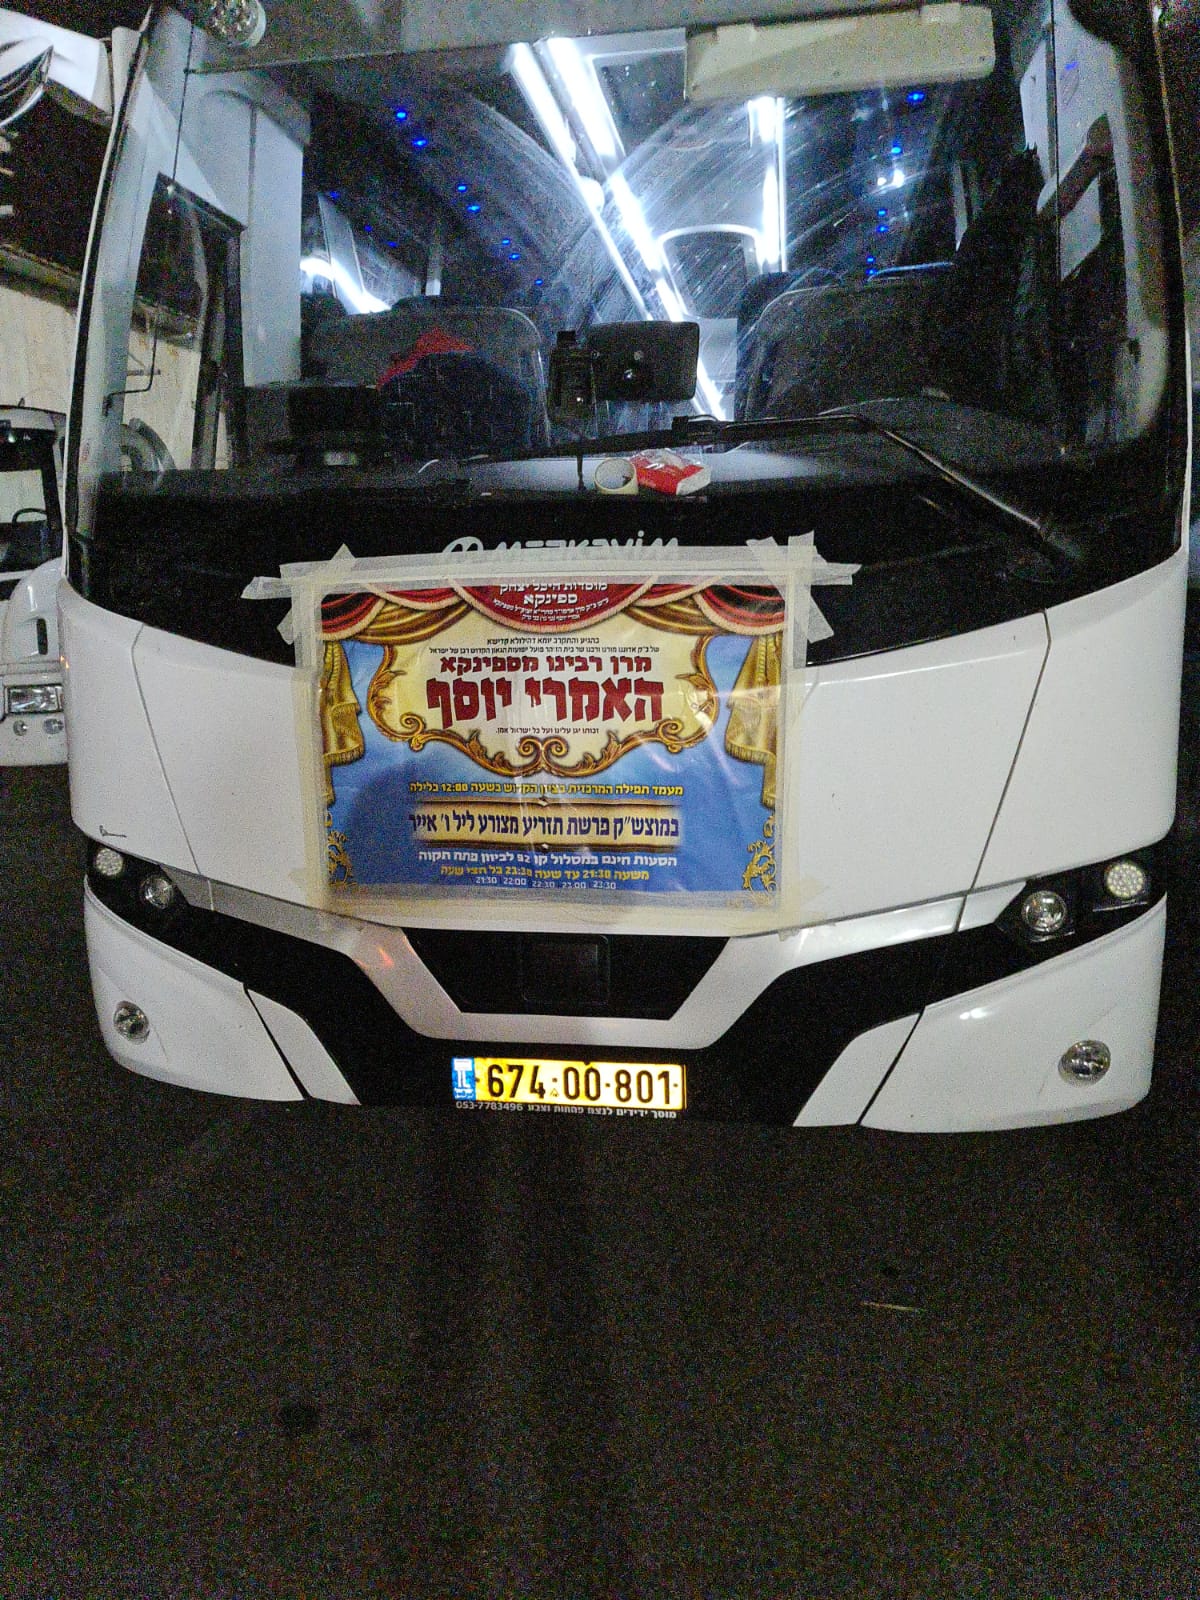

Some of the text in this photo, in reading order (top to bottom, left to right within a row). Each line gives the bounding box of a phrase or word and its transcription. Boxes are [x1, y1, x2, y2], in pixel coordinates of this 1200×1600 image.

[523, 594, 578, 608] ספינקא
[487, 638, 509, 646] קדישא
[510, 637, 536, 645] דהילולא
[553, 637, 579, 645] והתקרב
[440, 656, 652, 676] מרן רבינו מספינקא
[426, 677, 664, 729] האמרי יוסף
[410, 782, 439, 792] בלילה
[441, 783, 468, 792] 12:00
[471, 783, 502, 793] בשעה
[568, 784, 613, 795] המרכזית
[615, 783, 650, 795] תפילה
[652, 785, 684, 796] מעמד
[408, 814, 437, 832] אייר
[452, 810, 475, 832] ליל
[478, 814, 519, 834] מצורע
[522, 816, 563, 836] תזריע
[567, 816, 610, 835] פרשת
[613, 816, 679, 840] במוצש"ק
[418, 851, 451, 862] תקוה
[453, 851, 478, 862] פתח
[534, 855, 548, 866] קו
[550, 853, 599, 865] במסלול
[601, 855, 631, 865] חינם
[633, 855, 678, 867] הסעות
[440, 865, 464, 876] שעה
[488, 865, 503, 875] כל
[534, 868, 562, 880] שעה
[564, 870, 580, 880] עד
[614, 871, 650, 881] משעה
[650, 1110, 677, 1119] מוסך
